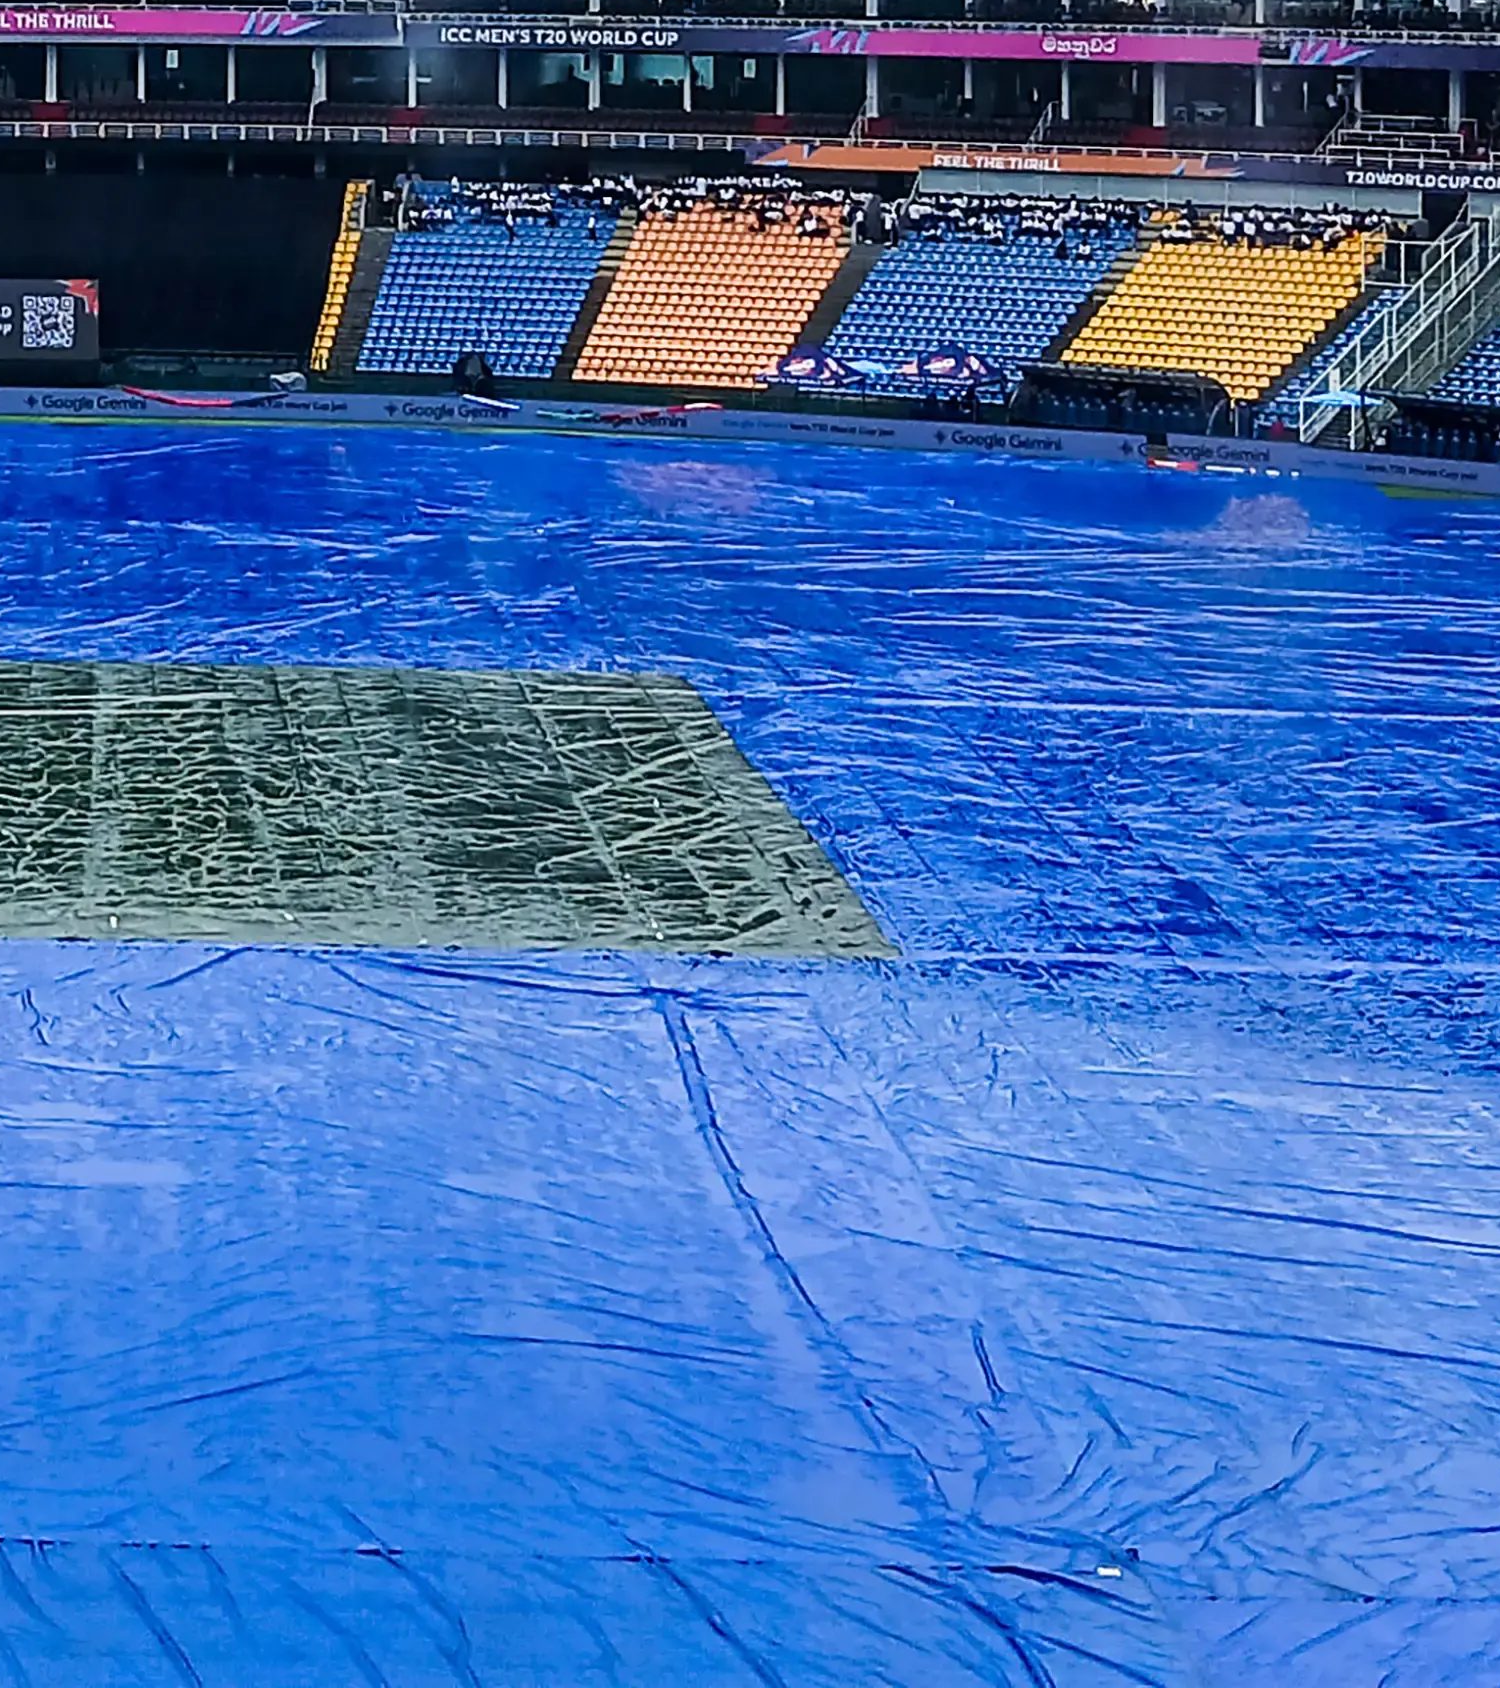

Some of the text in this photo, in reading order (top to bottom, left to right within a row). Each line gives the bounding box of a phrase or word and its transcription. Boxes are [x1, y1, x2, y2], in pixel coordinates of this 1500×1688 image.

[13, 13, 49, 29] THE
[51, 13, 115, 29] THRILL
[440, 28, 679, 47] ICC MEN'S T20 WORLD CUP
